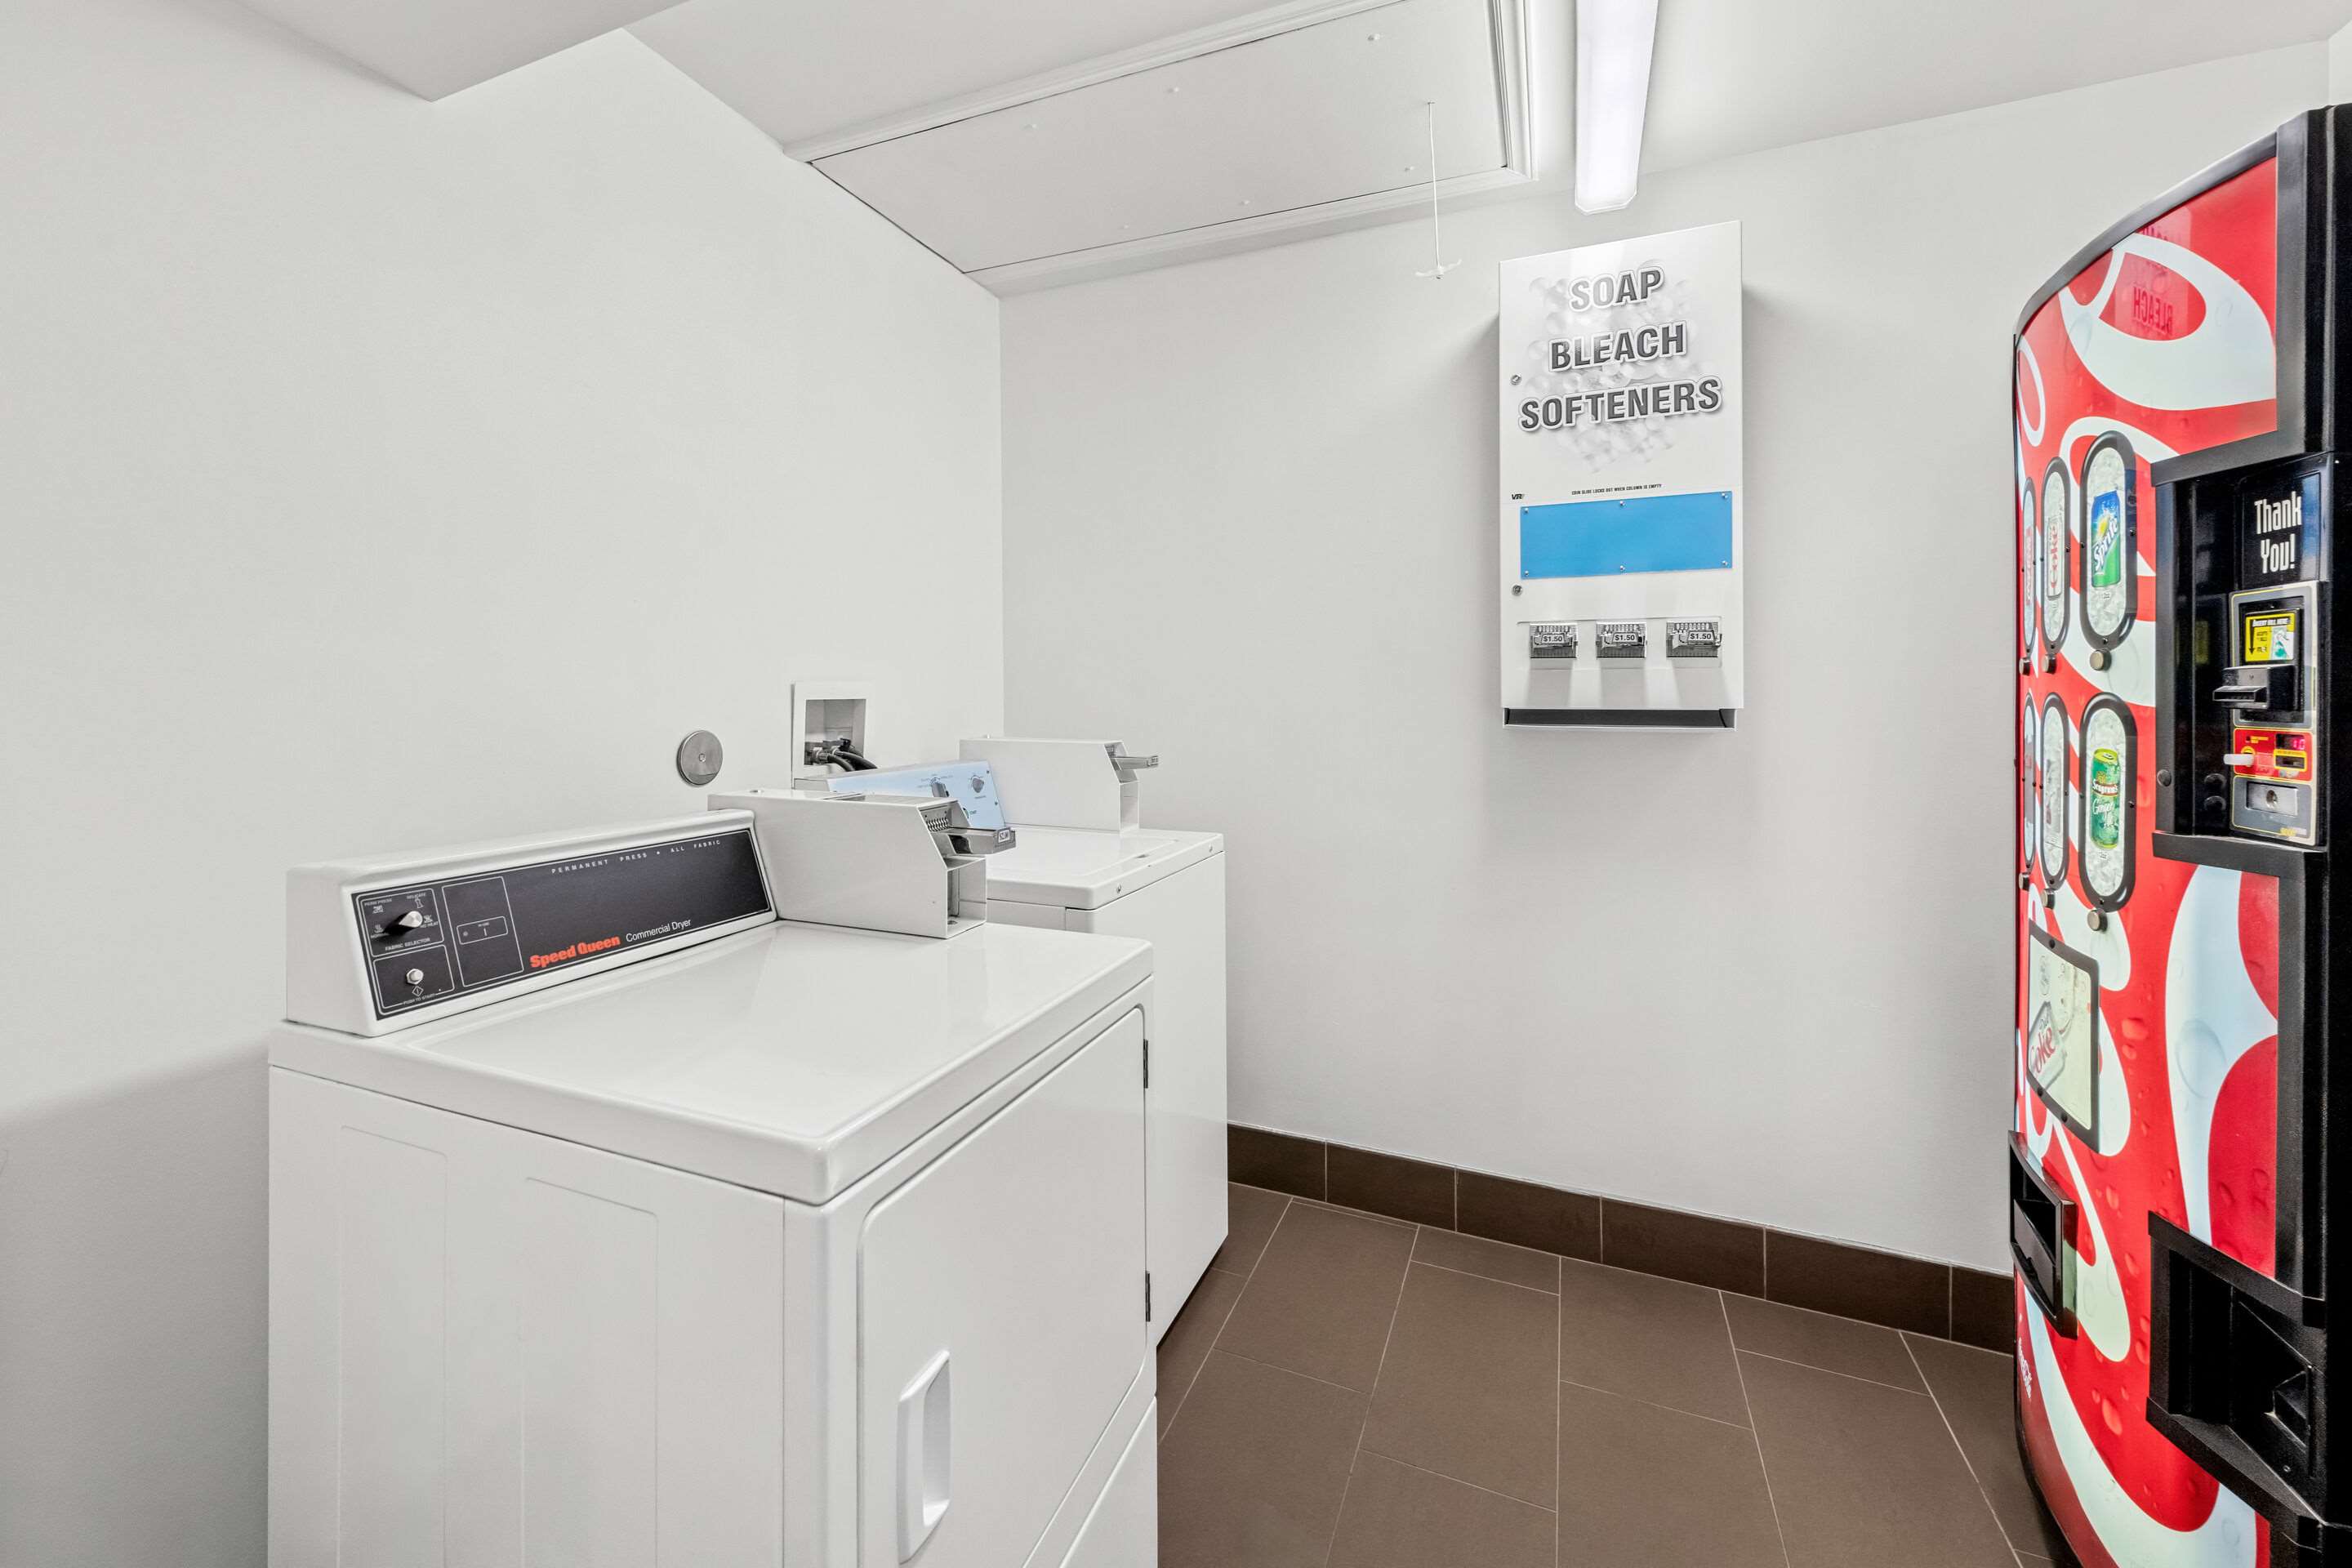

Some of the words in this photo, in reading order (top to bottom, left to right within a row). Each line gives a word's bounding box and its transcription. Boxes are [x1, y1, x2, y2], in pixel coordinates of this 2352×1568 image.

[1570, 269, 1663, 310] SOAP
[1551, 323, 1685, 370] BLEACH
[1521, 378, 1721, 430] SOFTENERS
[2254, 490, 2302, 535] Thank
[2260, 532, 2296, 574] You!
[550, 859, 609, 874] PERMANENT
[619, 853, 648, 862] PRESS
[693, 840, 721, 849] FABRIC
[626, 924, 671, 942] Commercial
[671, 919, 692, 932] Dryer
[529, 945, 577, 968] Speed
[577, 935, 621, 955] Queen
